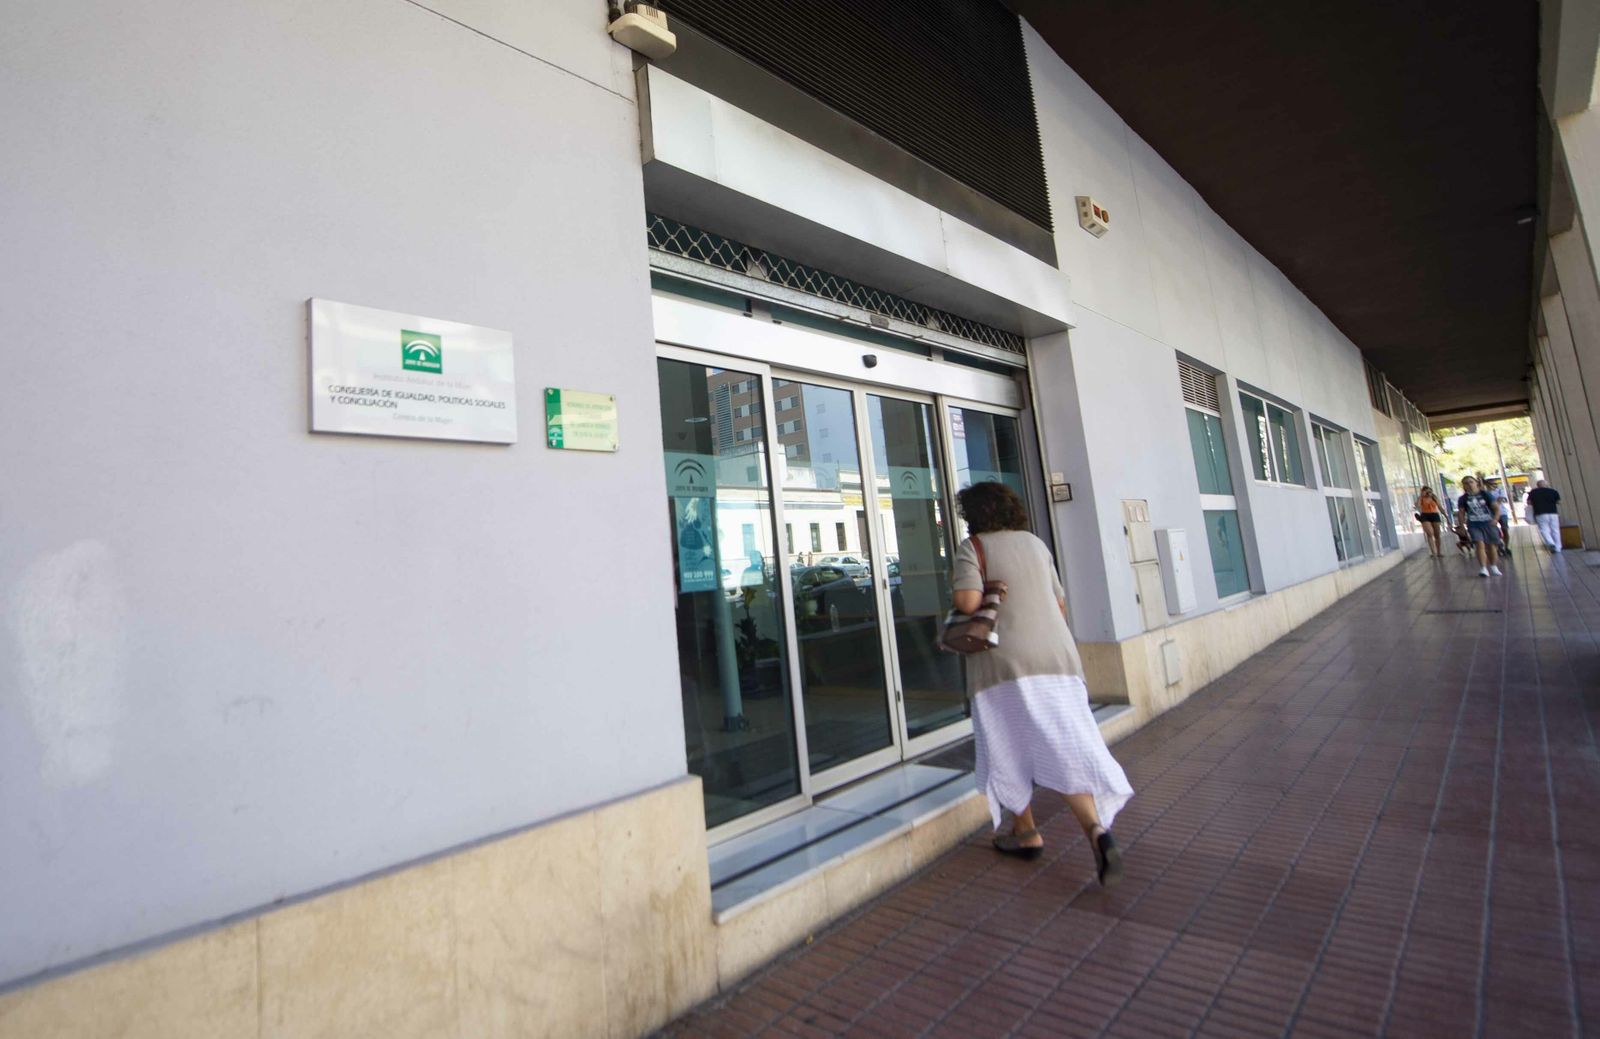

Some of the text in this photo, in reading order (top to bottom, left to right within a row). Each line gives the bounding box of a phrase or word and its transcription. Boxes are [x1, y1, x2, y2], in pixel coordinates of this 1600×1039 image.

[330, 395, 398, 408] Y CONCILIACIÓN
[381, 389, 392, 398] DE
[474, 399, 506, 409] SOCIALES
